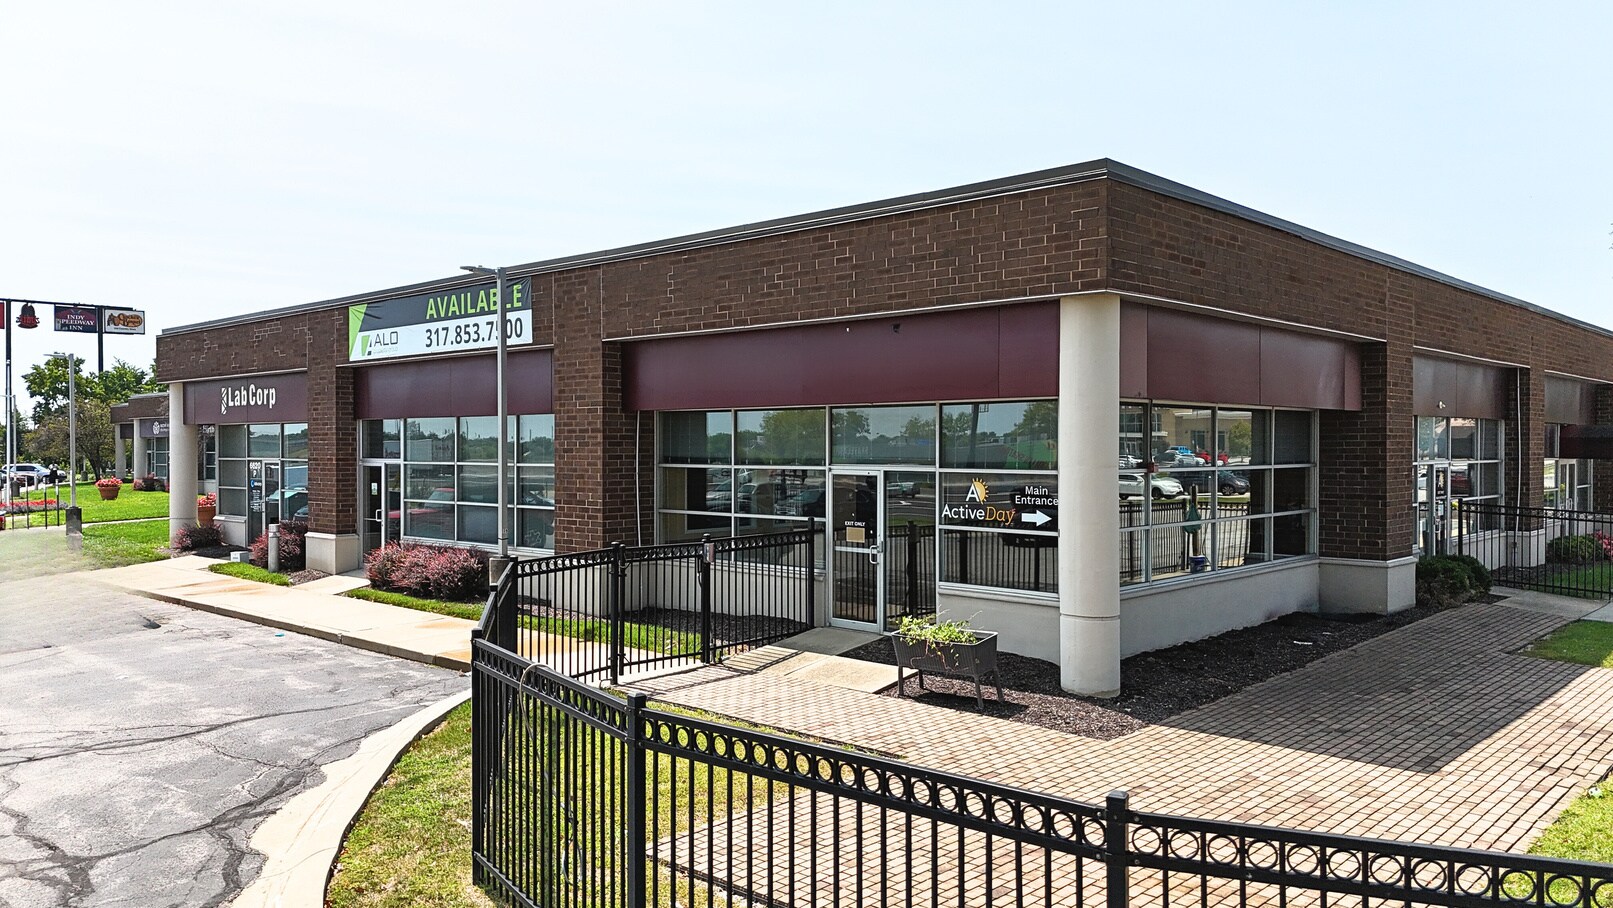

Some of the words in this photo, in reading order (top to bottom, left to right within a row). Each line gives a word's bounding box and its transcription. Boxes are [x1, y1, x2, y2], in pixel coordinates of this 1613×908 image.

[374, 331, 398, 347] ALO
[228, 384, 276, 409] LabCorp
[1025, 485, 1048, 495] Main
[1015, 495, 1058, 506] Entrance
[942, 503, 1015, 526] ActiveDay
